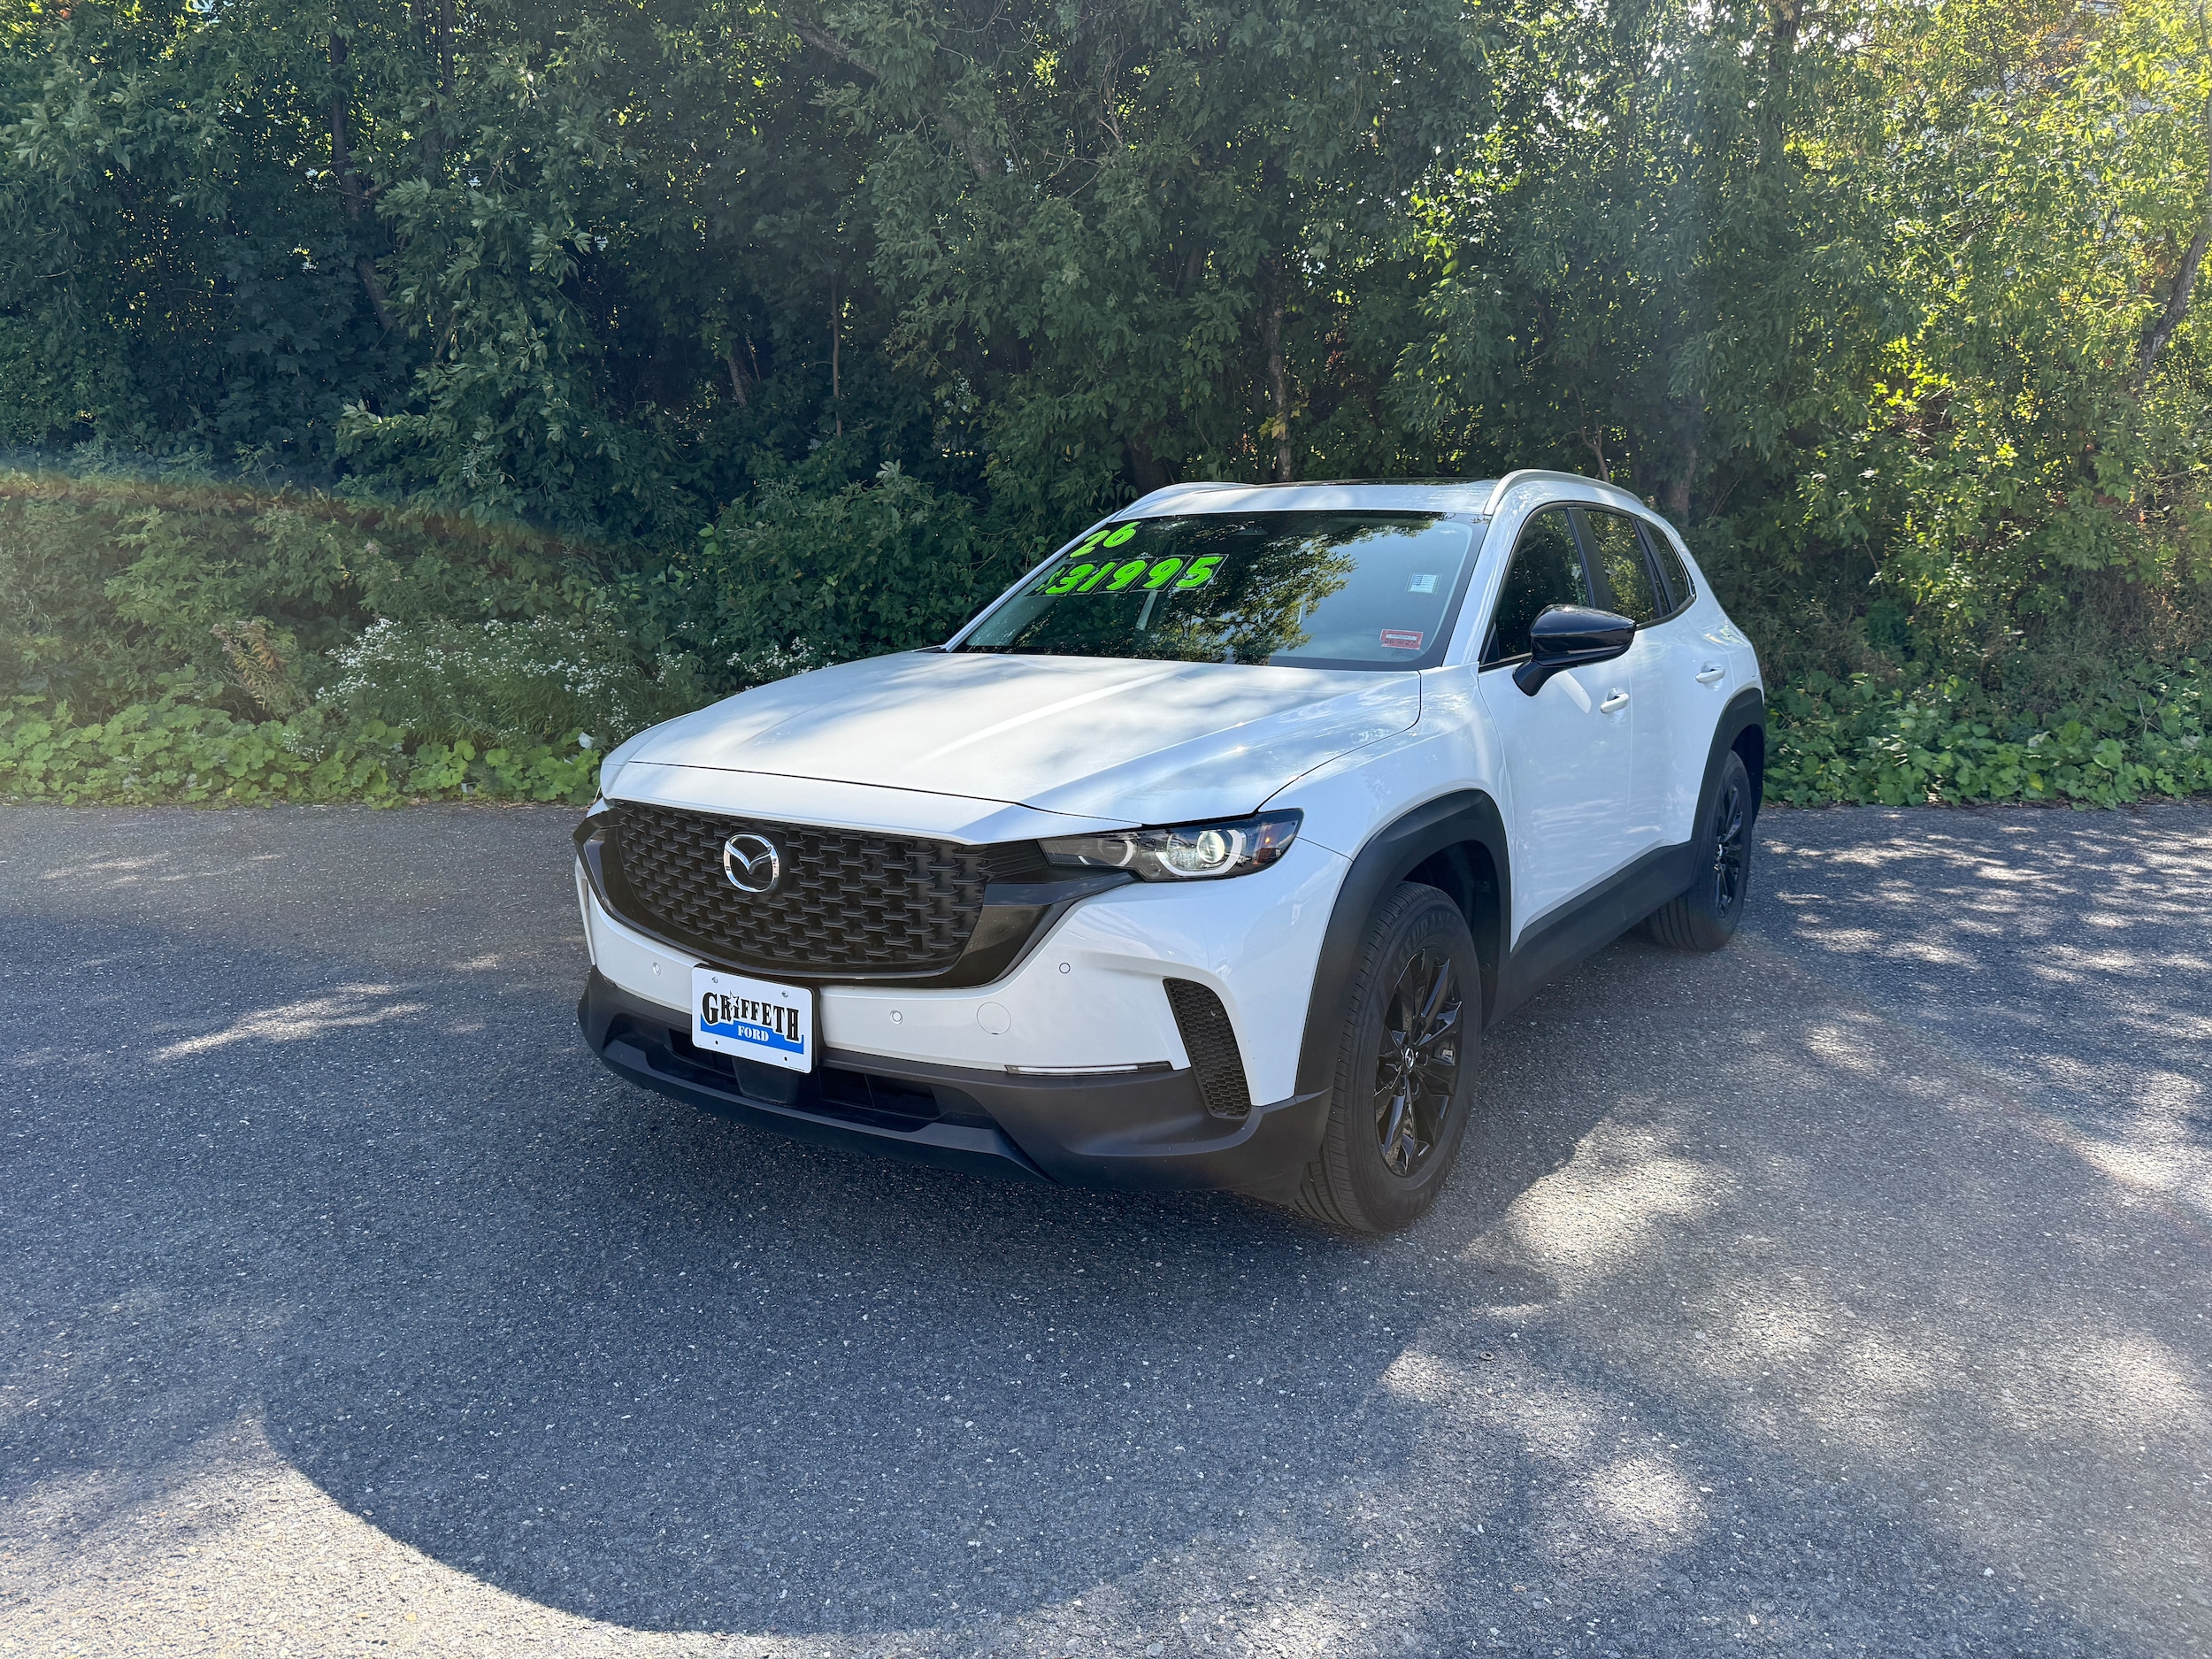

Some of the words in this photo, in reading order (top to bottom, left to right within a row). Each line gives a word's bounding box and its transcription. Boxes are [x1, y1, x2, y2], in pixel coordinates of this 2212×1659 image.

[1069, 521, 1141, 558] 26
[702, 991, 799, 1041] GRIFFETH
[737, 1025, 770, 1042] FORD
